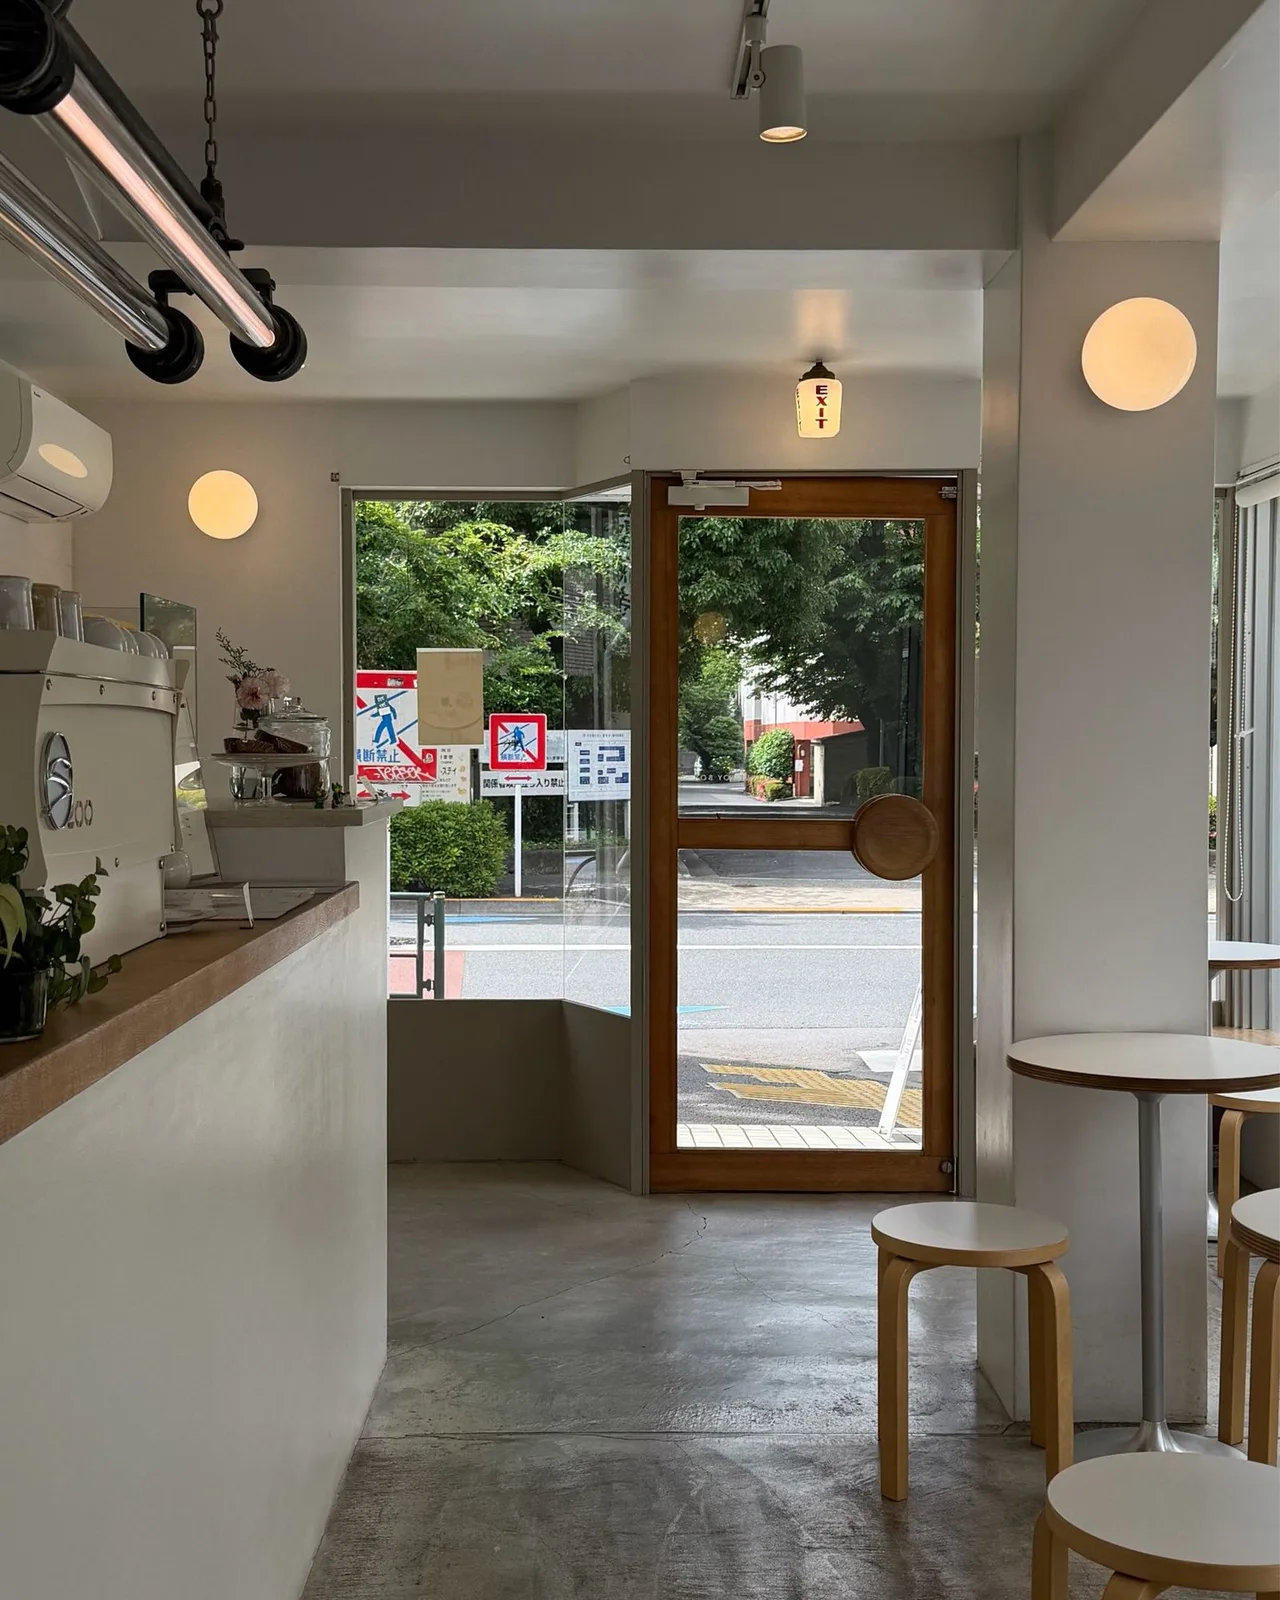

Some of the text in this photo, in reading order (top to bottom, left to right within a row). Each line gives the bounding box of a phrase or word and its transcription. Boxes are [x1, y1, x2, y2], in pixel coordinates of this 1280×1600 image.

[815, 385, 828, 429] EXIT
[483, 777, 565, 789] 関係入り禁止
